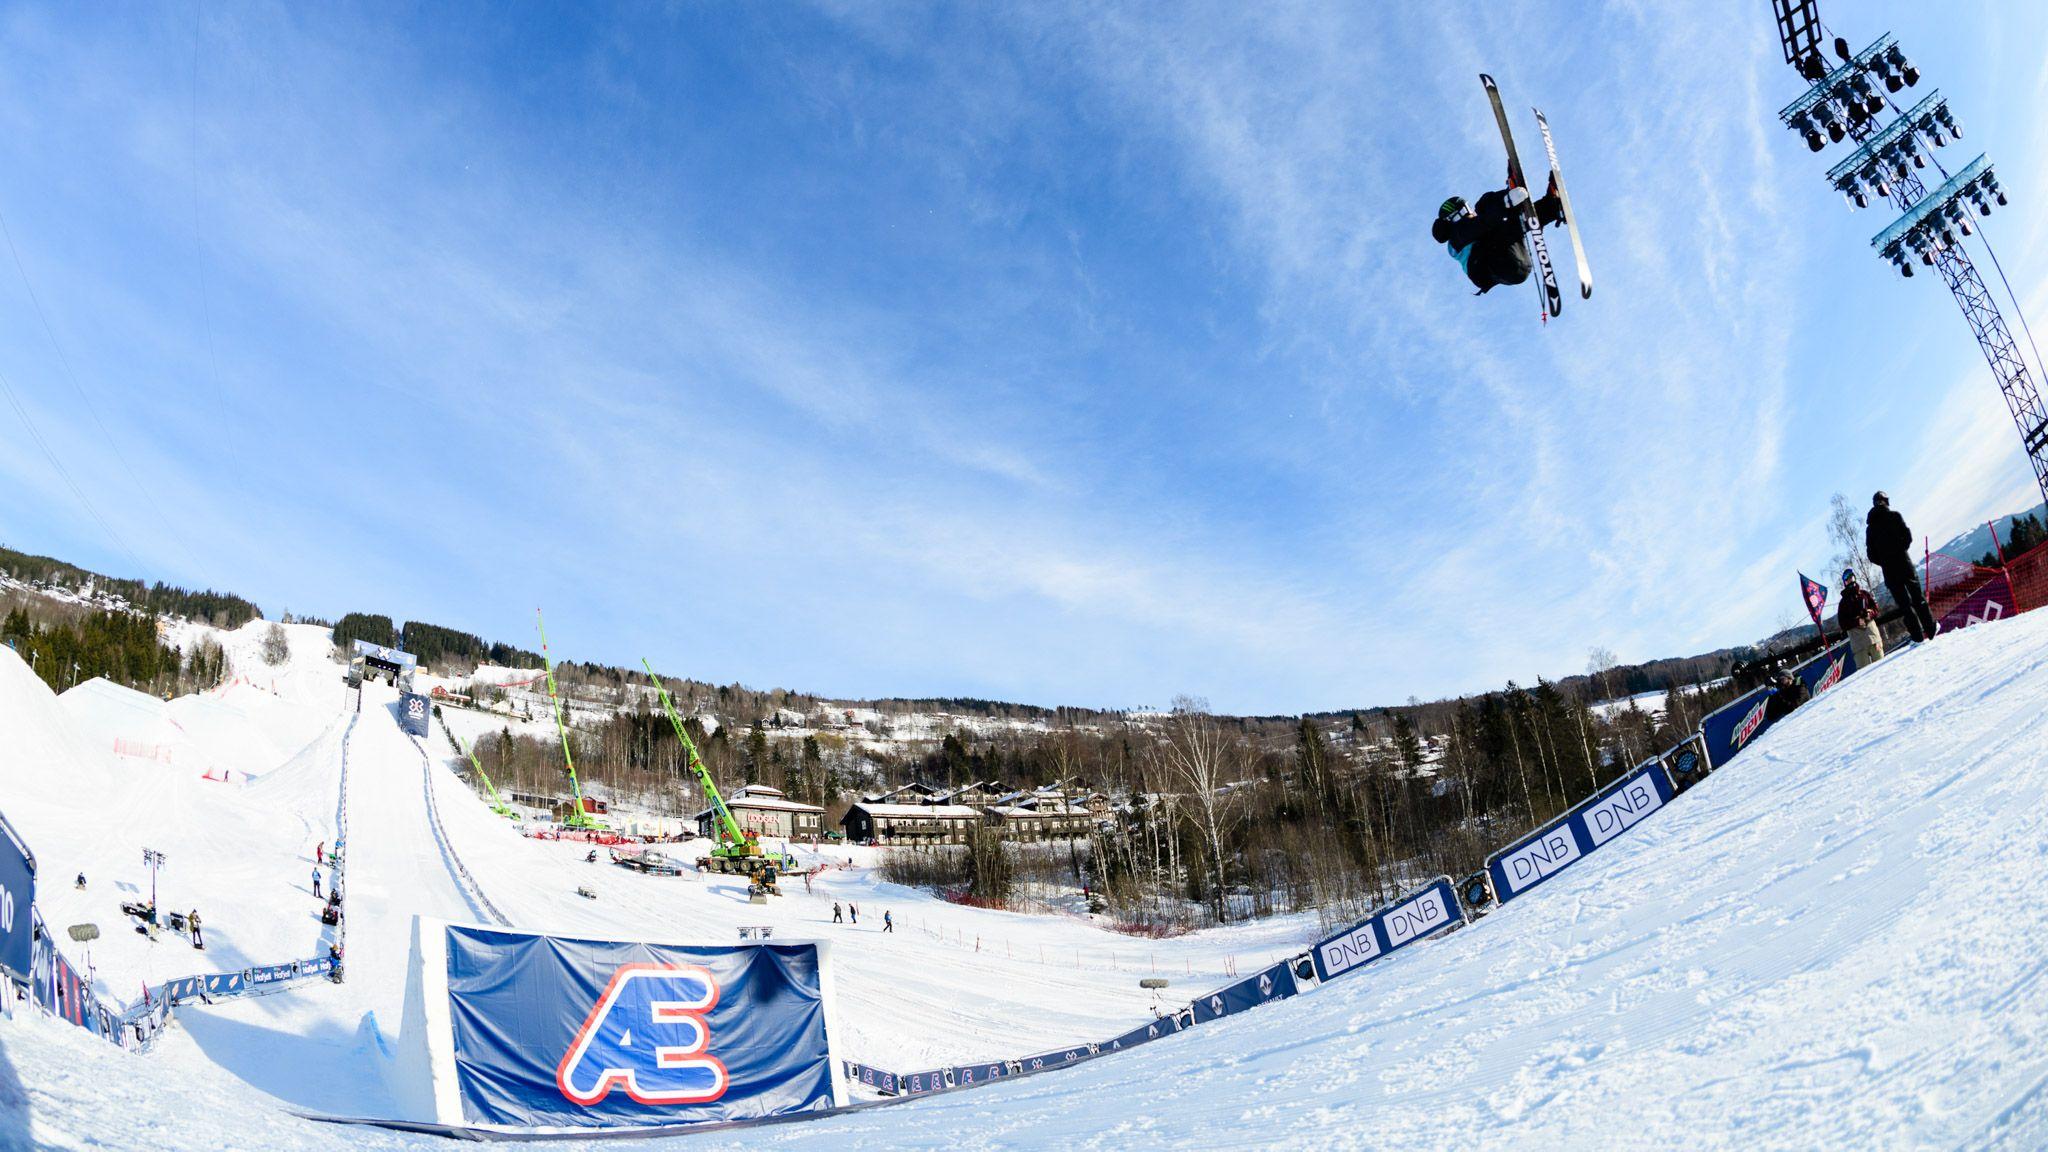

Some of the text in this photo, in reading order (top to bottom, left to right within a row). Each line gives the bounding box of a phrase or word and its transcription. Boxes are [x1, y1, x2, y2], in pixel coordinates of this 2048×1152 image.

[1528, 216, 1557, 288] ATOMIC
[1594, 786, 1650, 834] DNB
[1512, 836, 1569, 880] DNB
[1391, 899, 1439, 936] DNB
[1328, 932, 1372, 968] DNB
